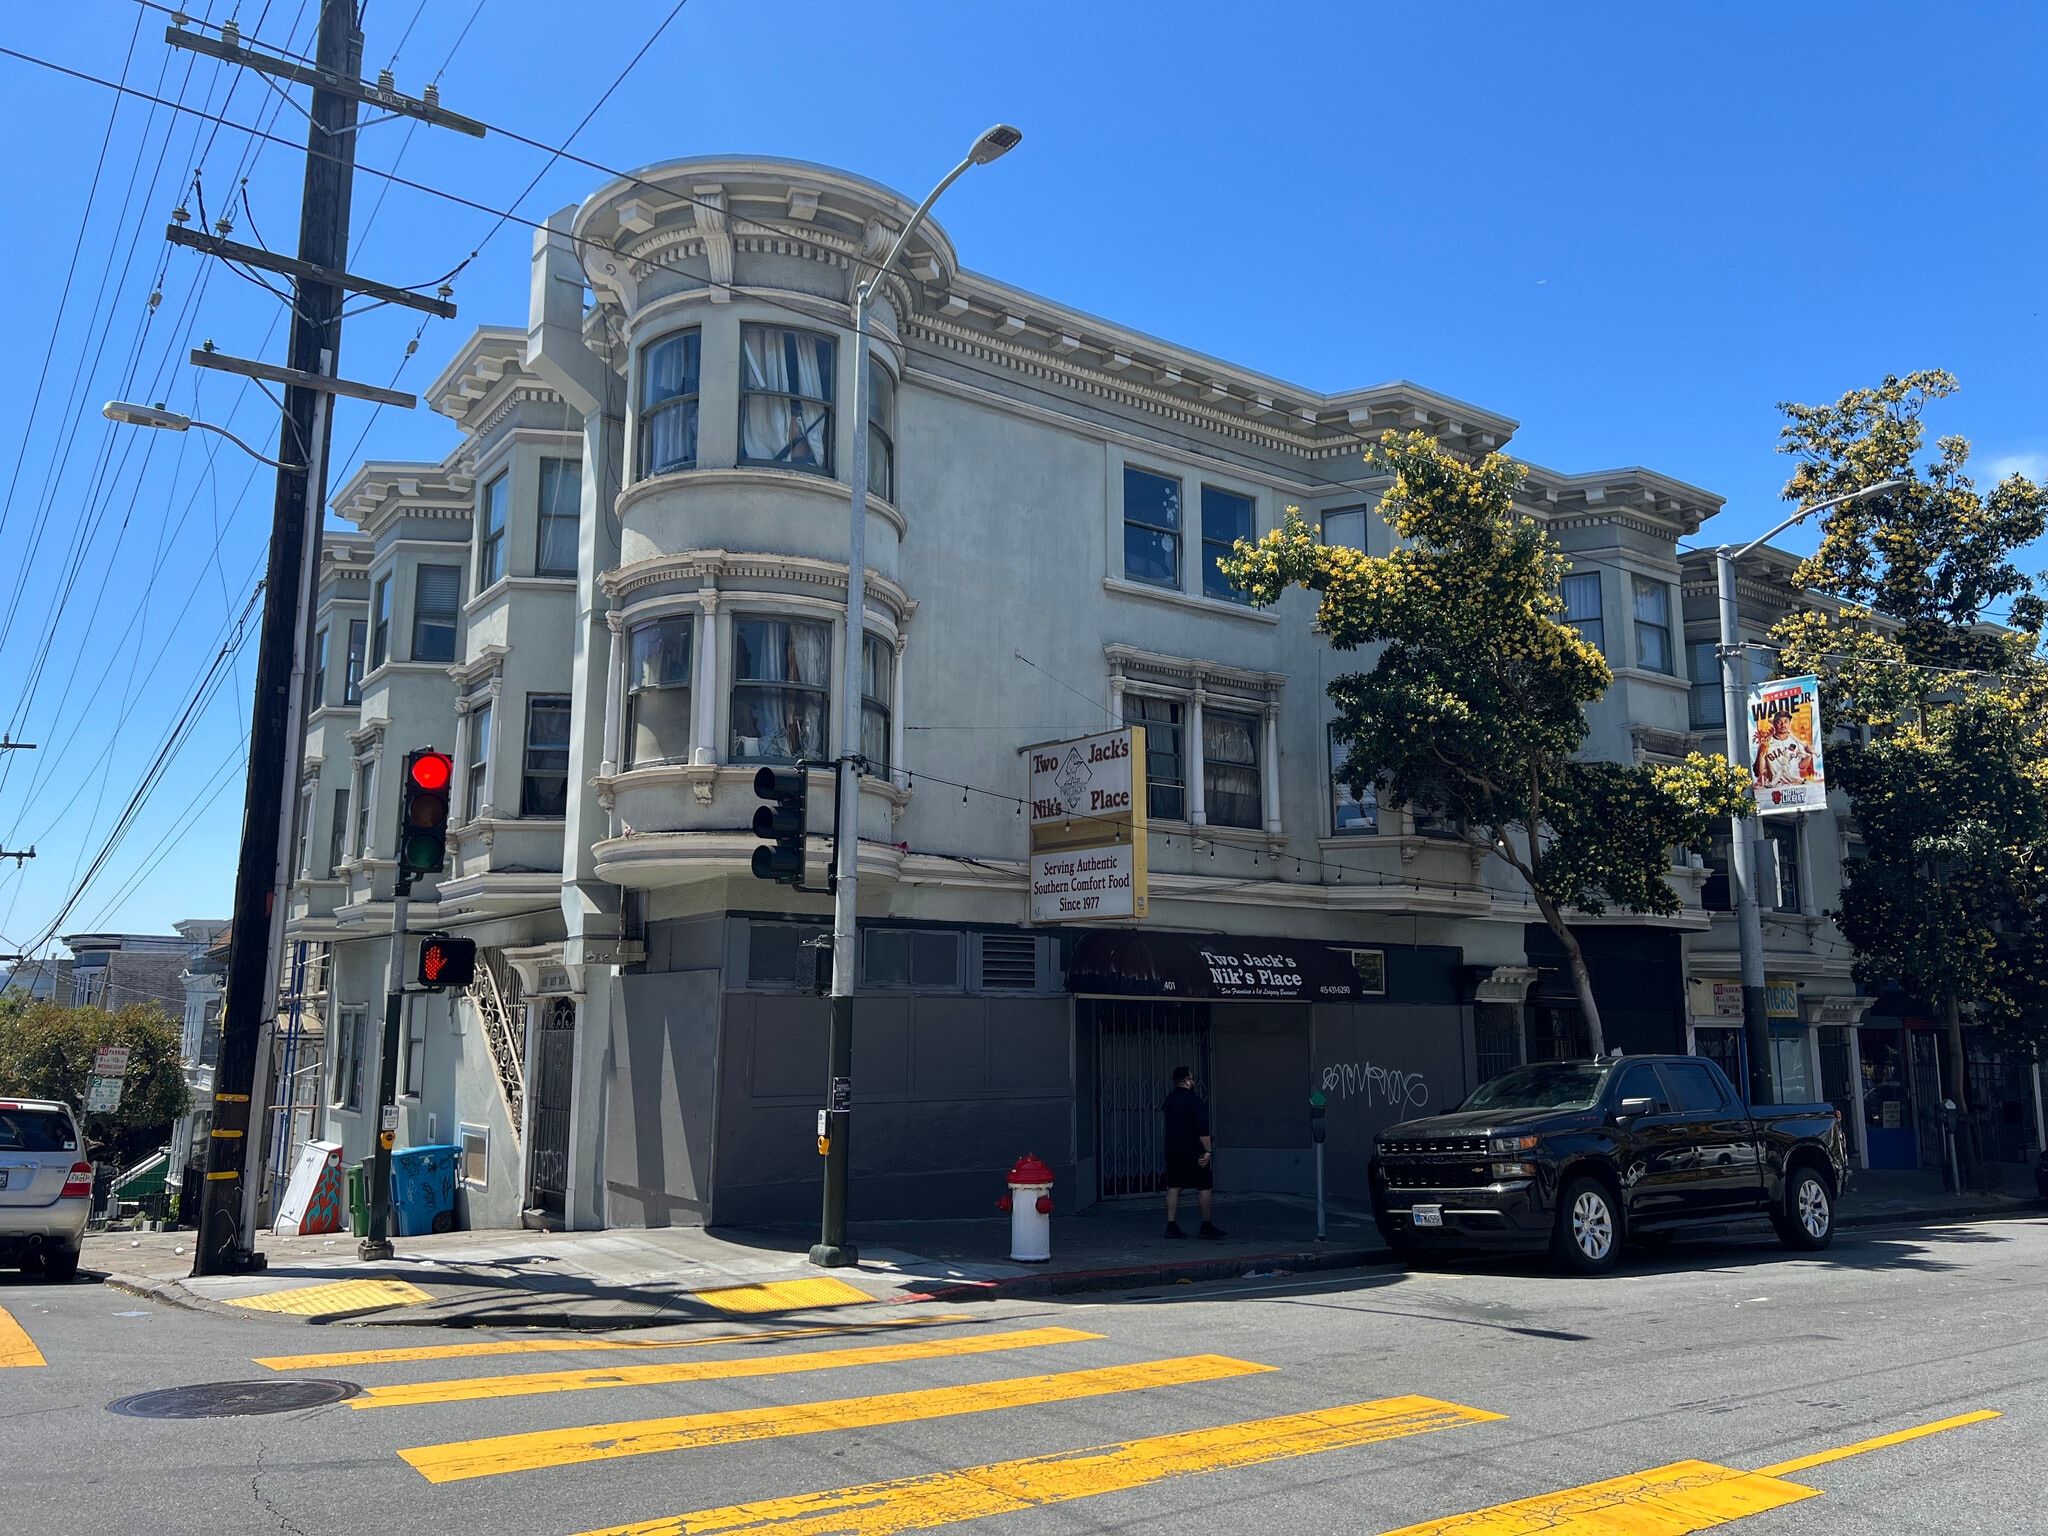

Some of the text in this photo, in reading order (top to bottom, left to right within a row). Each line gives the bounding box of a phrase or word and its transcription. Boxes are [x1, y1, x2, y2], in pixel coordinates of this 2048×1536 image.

[1752, 692, 1815, 721] WADE JR.
[1033, 738, 1129, 774] Two Jack's
[1032, 789, 1130, 820] Nik's Place
[1044, 855, 1118, 876] Serving Authentic
[1034, 873, 1130, 895] Southern Comfort Food
[1059, 896, 1099, 912] Since 1977
[1200, 951, 1297, 968] Two Jack's
[1164, 981, 1176, 990] 401
[1209, 968, 1303, 986] Nik's Place
[98, 1047, 108, 1055] NO
